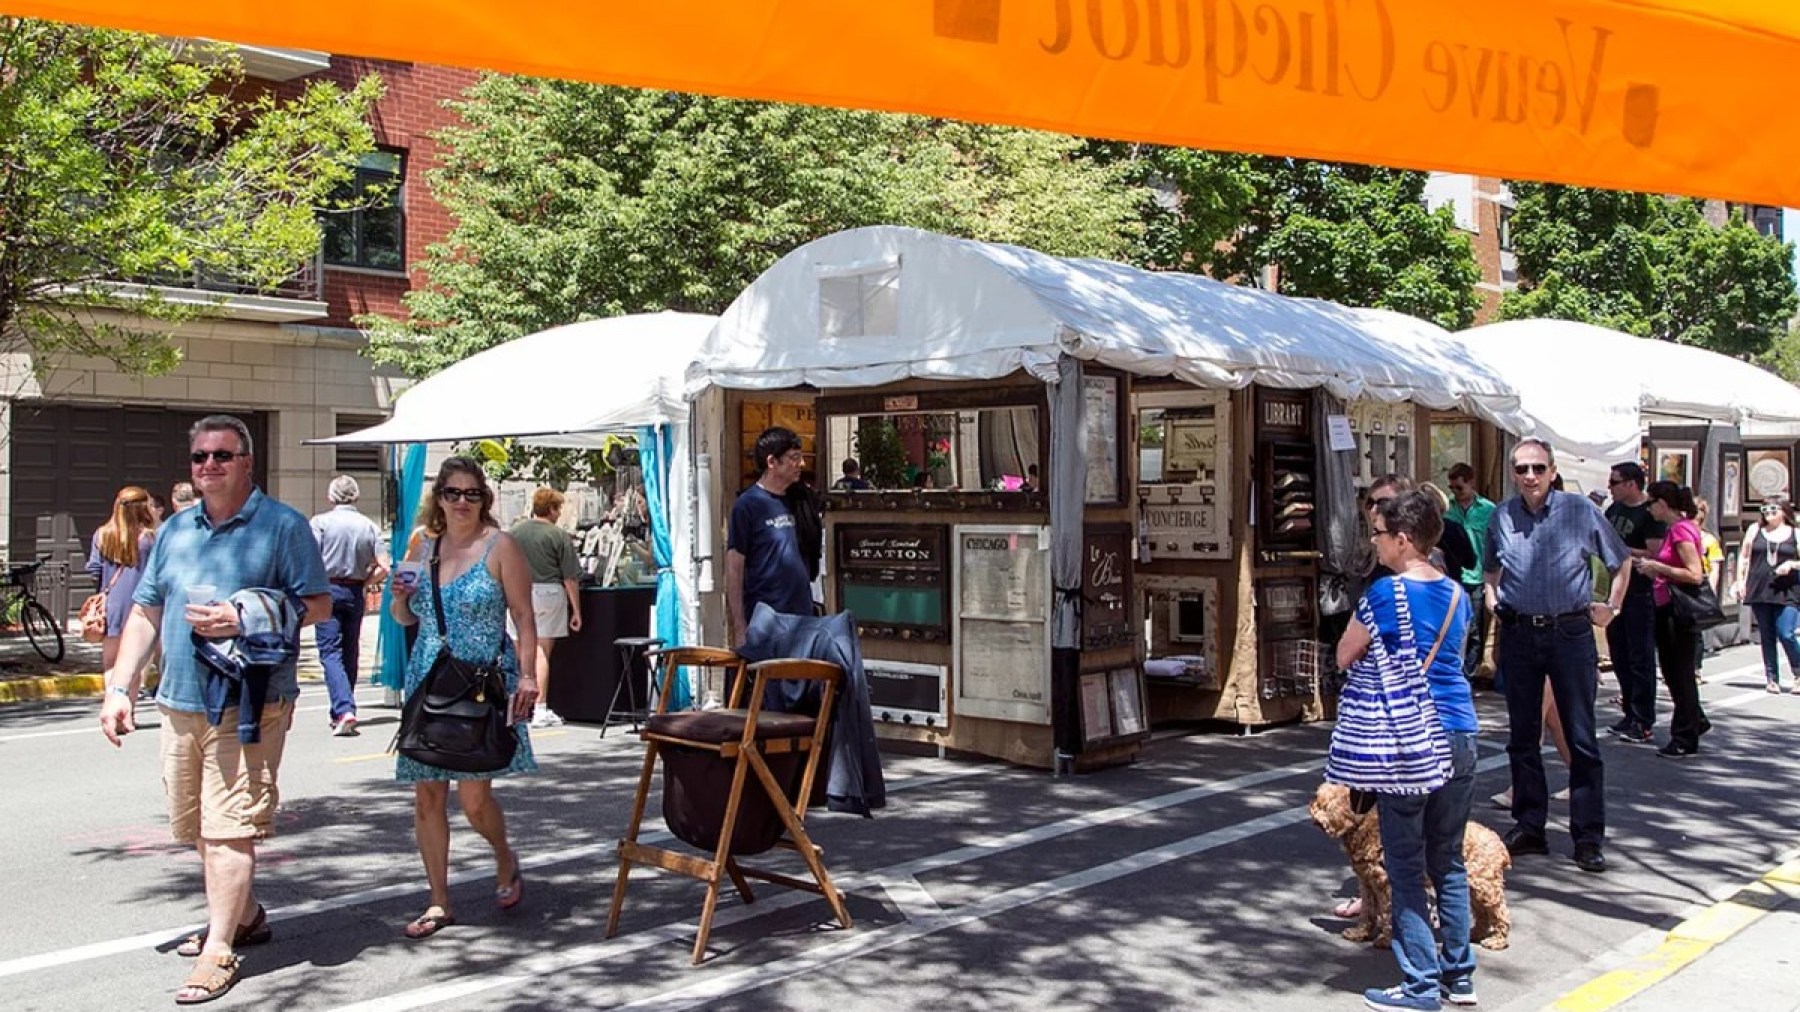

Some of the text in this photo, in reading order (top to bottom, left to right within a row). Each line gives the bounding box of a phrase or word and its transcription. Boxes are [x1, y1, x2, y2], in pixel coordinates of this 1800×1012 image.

[1265, 402, 1303, 426] LIBRARY
[965, 538, 1009, 550] CHICAGO
[850, 549, 931, 560] STATION
